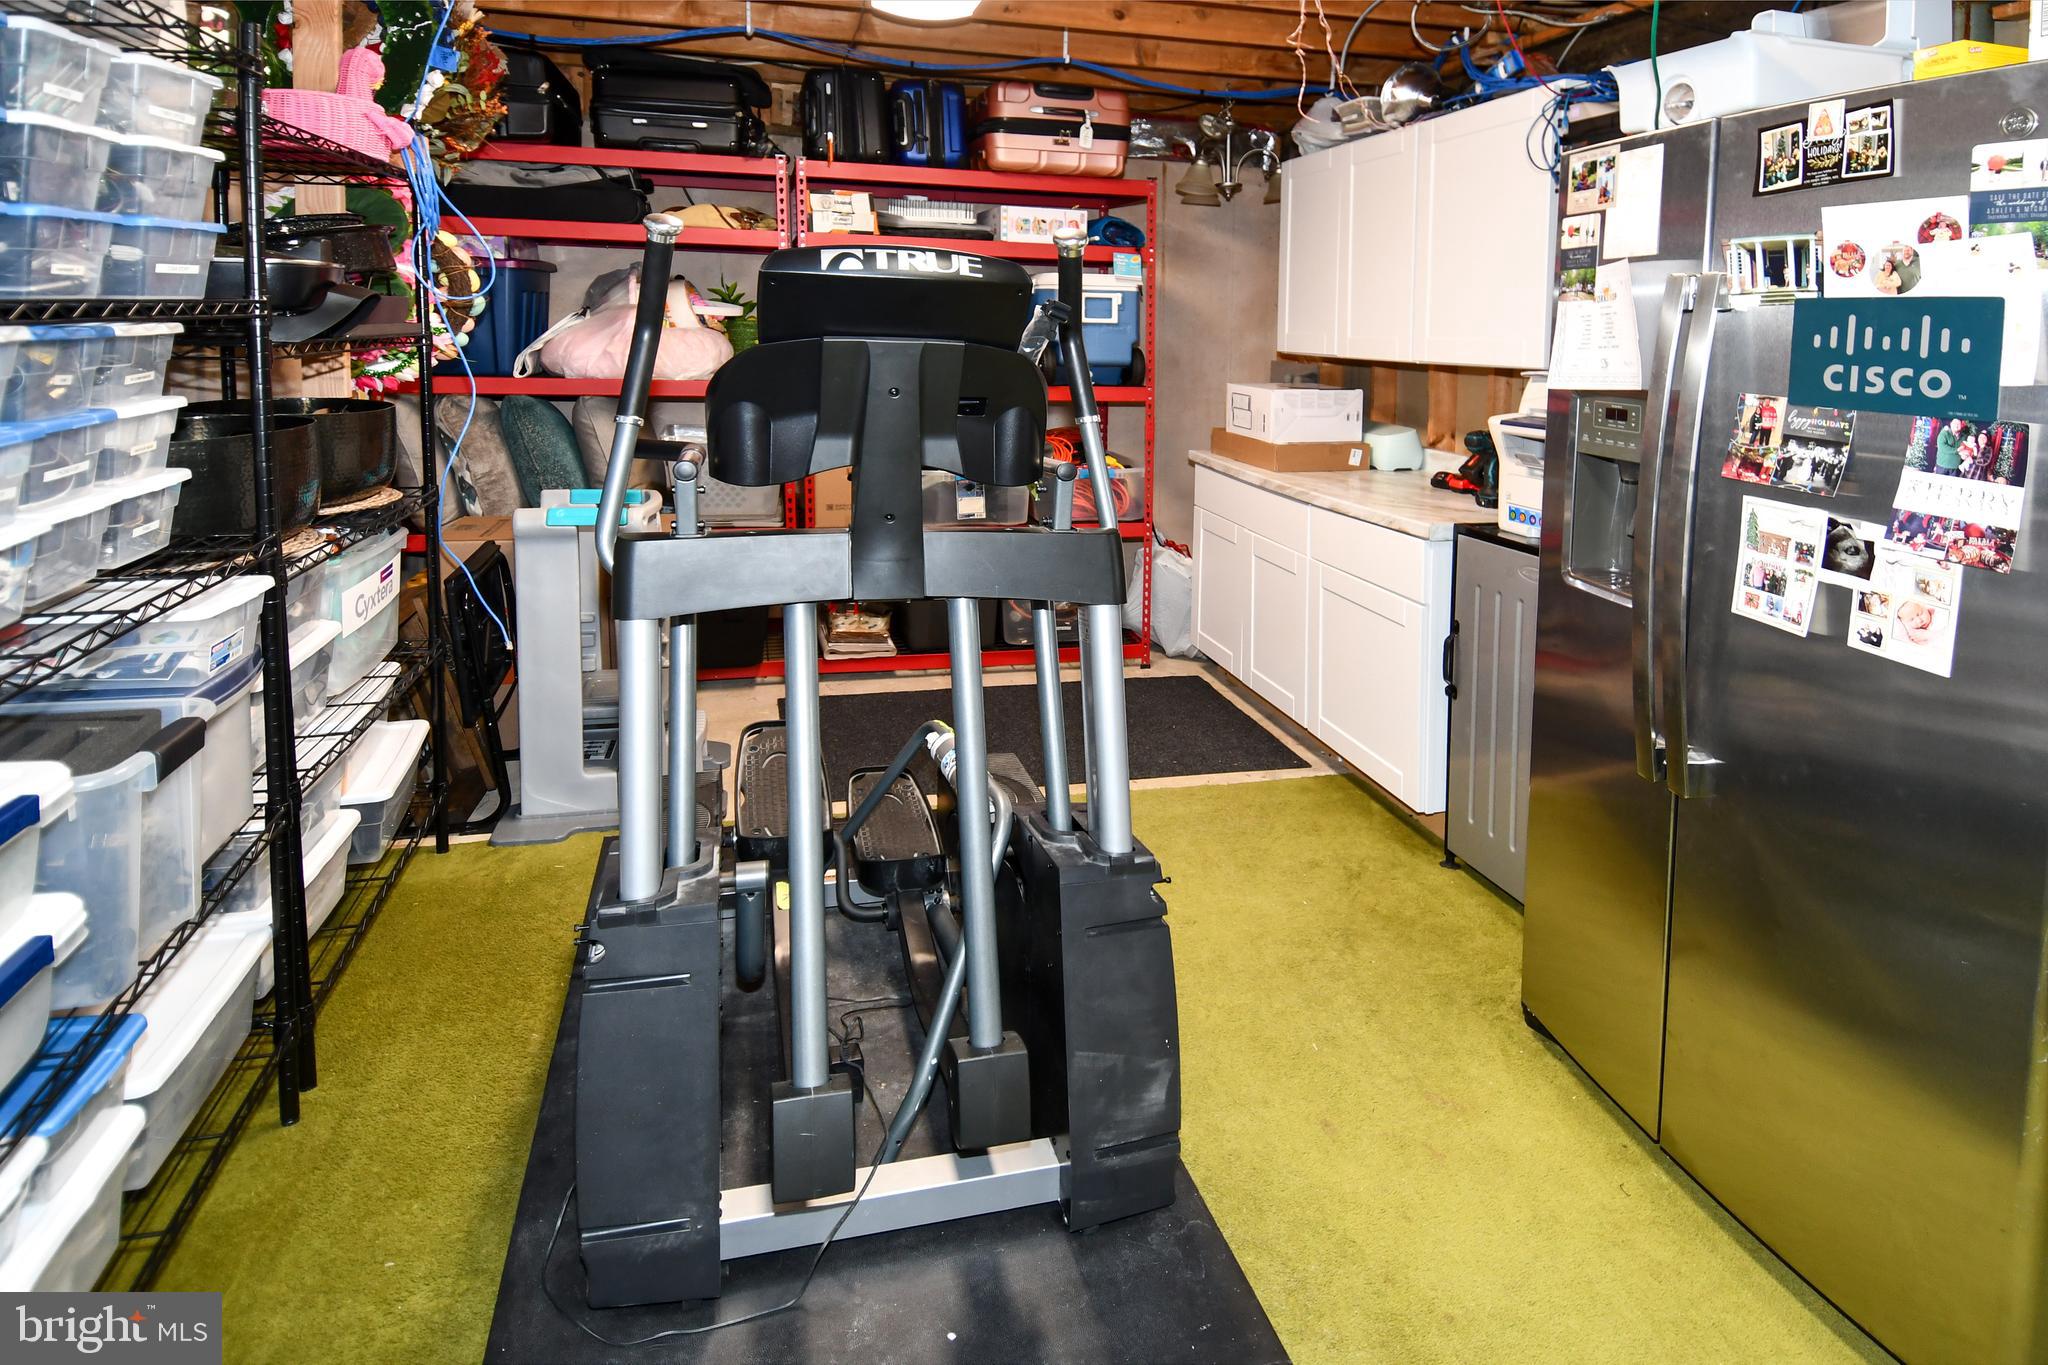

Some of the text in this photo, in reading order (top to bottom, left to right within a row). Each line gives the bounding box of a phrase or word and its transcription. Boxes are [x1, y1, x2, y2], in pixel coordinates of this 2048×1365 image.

[1986, 206, 2013, 214] ASHLEY
[864, 248, 983, 277] TRUE
[1823, 364, 1952, 398] CISCO
[1811, 418, 1850, 429] HOLIDAYS
[355, 579, 394, 620] Cyxtera
